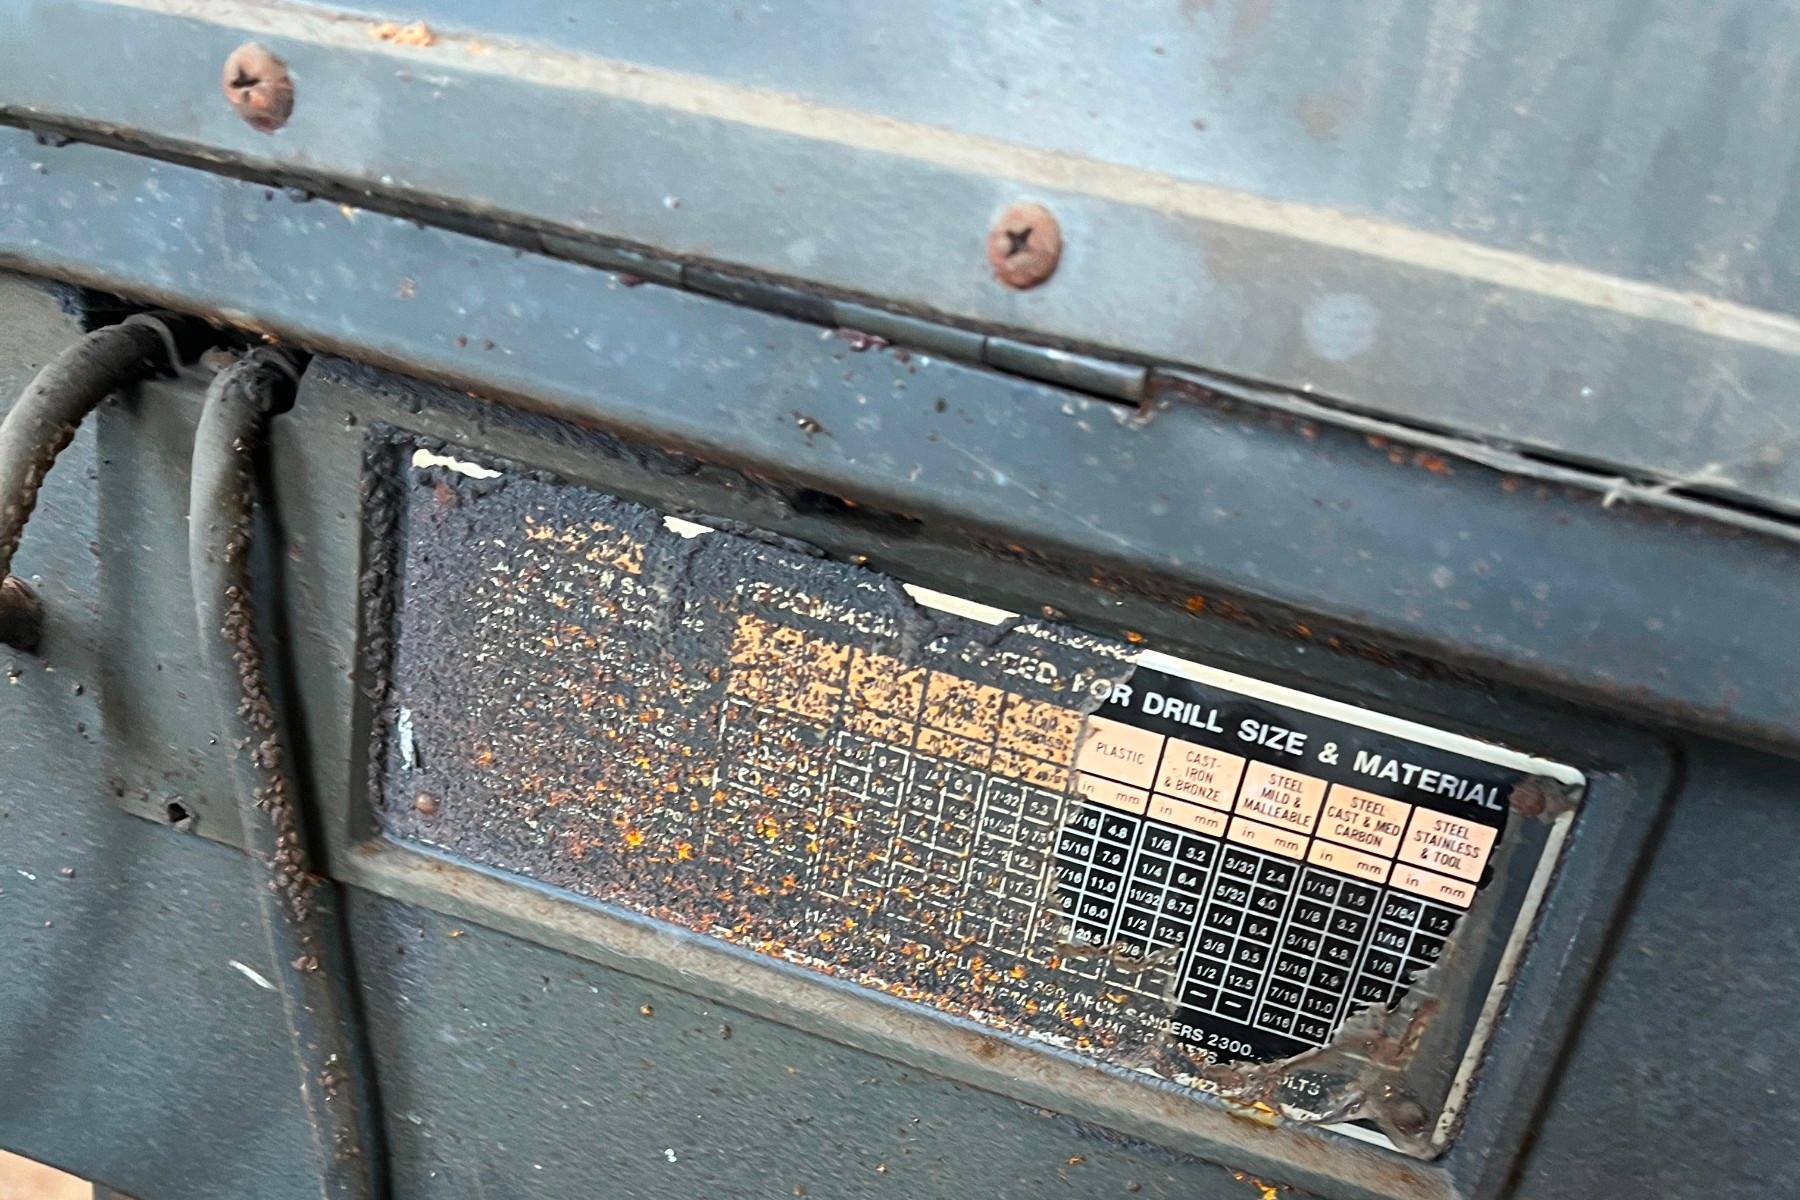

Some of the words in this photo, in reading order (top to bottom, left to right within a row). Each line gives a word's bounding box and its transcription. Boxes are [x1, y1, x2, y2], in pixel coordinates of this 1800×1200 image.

[1096, 742, 1145, 765] PLASTIC
[1142, 691, 1223, 733] DRILL
[1237, 718, 1308, 756] SIZE
[1317, 742, 1339, 765] &
[1352, 750, 1503, 811] MATERIAL
[1185, 767, 1214, 783] IRON
[1268, 773, 1304, 794] STEEL
[1163, 776, 1171, 788] &
[1175, 779, 1221, 802] BRONZE
[1261, 787, 1290, 805] MILD
[1293, 796, 1301, 808] &
[1243, 797, 1312, 828] MALLEABLE
[1350, 796, 1386, 817] STEEL
[1108, 825, 1128, 839] 4.8
[1327, 806, 1359, 825] CAST
[1362, 816, 1371, 829] &
[1374, 820, 1401, 837] MED
[1434, 819, 1470, 840] STEEL
[1116, 792, 1140, 805] mm
[1160, 805, 1172, 815] in
[1194, 815, 1219, 828] mm
[1242, 829, 1255, 840] in
[1274, 838, 1299, 851] mm
[1320, 851, 1333, 862] in
[1356, 861, 1382, 874] mm
[1406, 875, 1419, 887] in
[1440, 885, 1466, 899] mm
[1334, 825, 1383, 848] CARBON
[1414, 830, 1480, 859] STAINLESS
[1061, 840, 1090, 856] 5/16
[1102, 851, 1121, 865] 7.9
[1151, 837, 1172, 851] 1/8
[1186, 847, 1206, 862] 3.2
[1420, 848, 1429, 860] &
[1433, 851, 1462, 870] TOOL
[1142, 863, 1162, 878] 1/4
[1178, 872, 1197, 887] 6.4
[1225, 857, 1255, 875] 3/32
[1266, 870, 1286, 883] 2.4
[1091, 876, 1116, 893] 11.0
[1306, 880, 1334, 897] 1/16
[1130, 888, 1161, 907] 11/32
[1166, 899, 1194, 915] 8.75
[1216, 885, 1246, 902] 5/32
[1257, 896, 1277, 910] 4.0
[1083, 903, 1108, 919] 16.0
[1213, 912, 1233, 926] 1/4
[1300, 909, 1321, 923] 1/8
[1337, 919, 1358, 933] 3.2
[1127, 916, 1147, 931] 1/2
[1159, 926, 1184, 942] 12.5
[1430, 917, 1449, 931] 1.2
[1075, 929, 1101, 945] 20.5
[1287, 934, 1317, 951] 3/16
[1377, 931, 1406, 948] 1/16
[1203, 939, 1225, 953] 3/8
[1240, 949, 1260, 963] 9.5
[1196, 965, 1217, 979] 1/2
[1229, 975, 1254, 990] 12.5
[1278, 961, 1308, 977] 5/16
[1372, 959, 1393, 974] 1/8
[1270, 987, 1299, 1003] 7/16
[1307, 998, 1333, 1014] 11.0
[1361, 985, 1382, 999] 1/4
[1262, 1012, 1290, 1028] 9/16
[1299, 1023, 1324, 1038] 14.5
